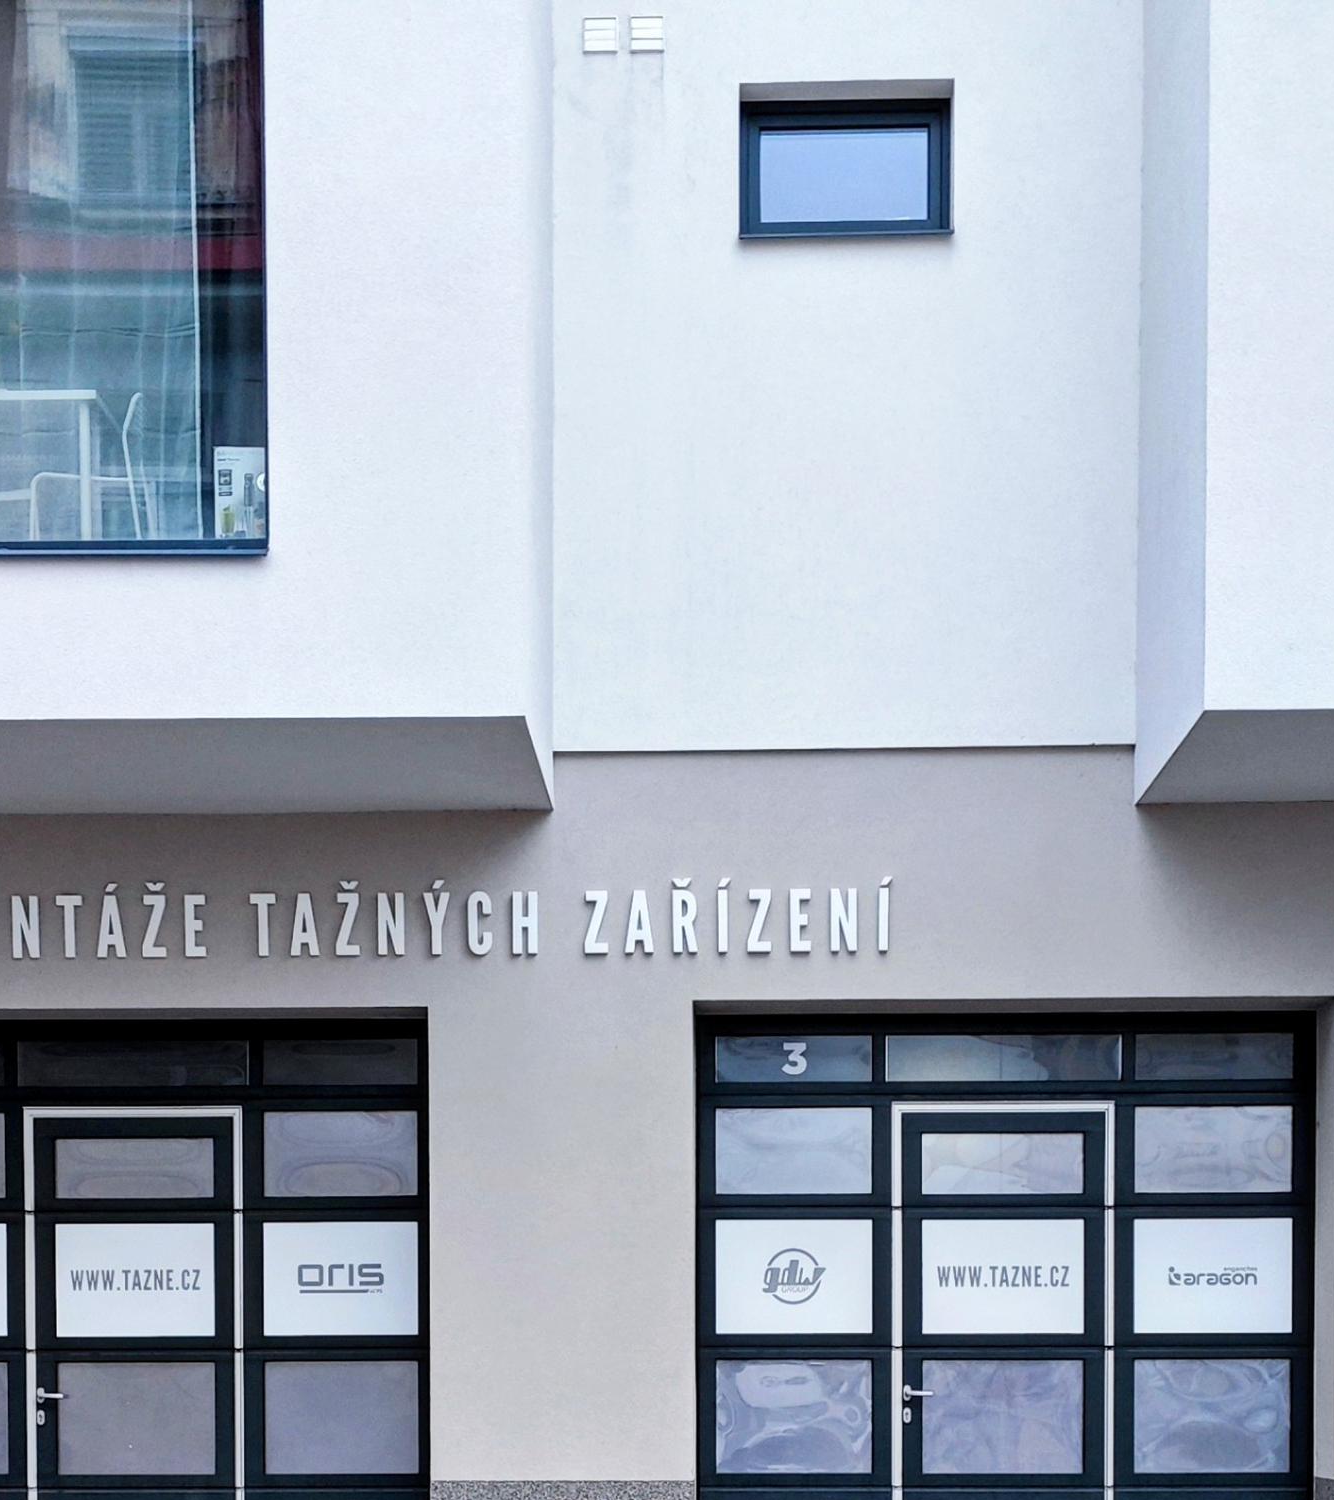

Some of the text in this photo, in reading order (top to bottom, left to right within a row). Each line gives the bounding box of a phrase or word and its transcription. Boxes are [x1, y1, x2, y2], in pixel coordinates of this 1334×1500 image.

[249, 879, 539, 957] TAŽNÝCH
[583, 875, 893, 956] ZAŘÍZENÍ
[781, 1041, 808, 1076] 3
[70, 1269, 201, 1291] WWW.TAZNE.CZ
[762, 1259, 827, 1293] gdw
[937, 1265, 1070, 1288] WWW.TAZNE.CZ
